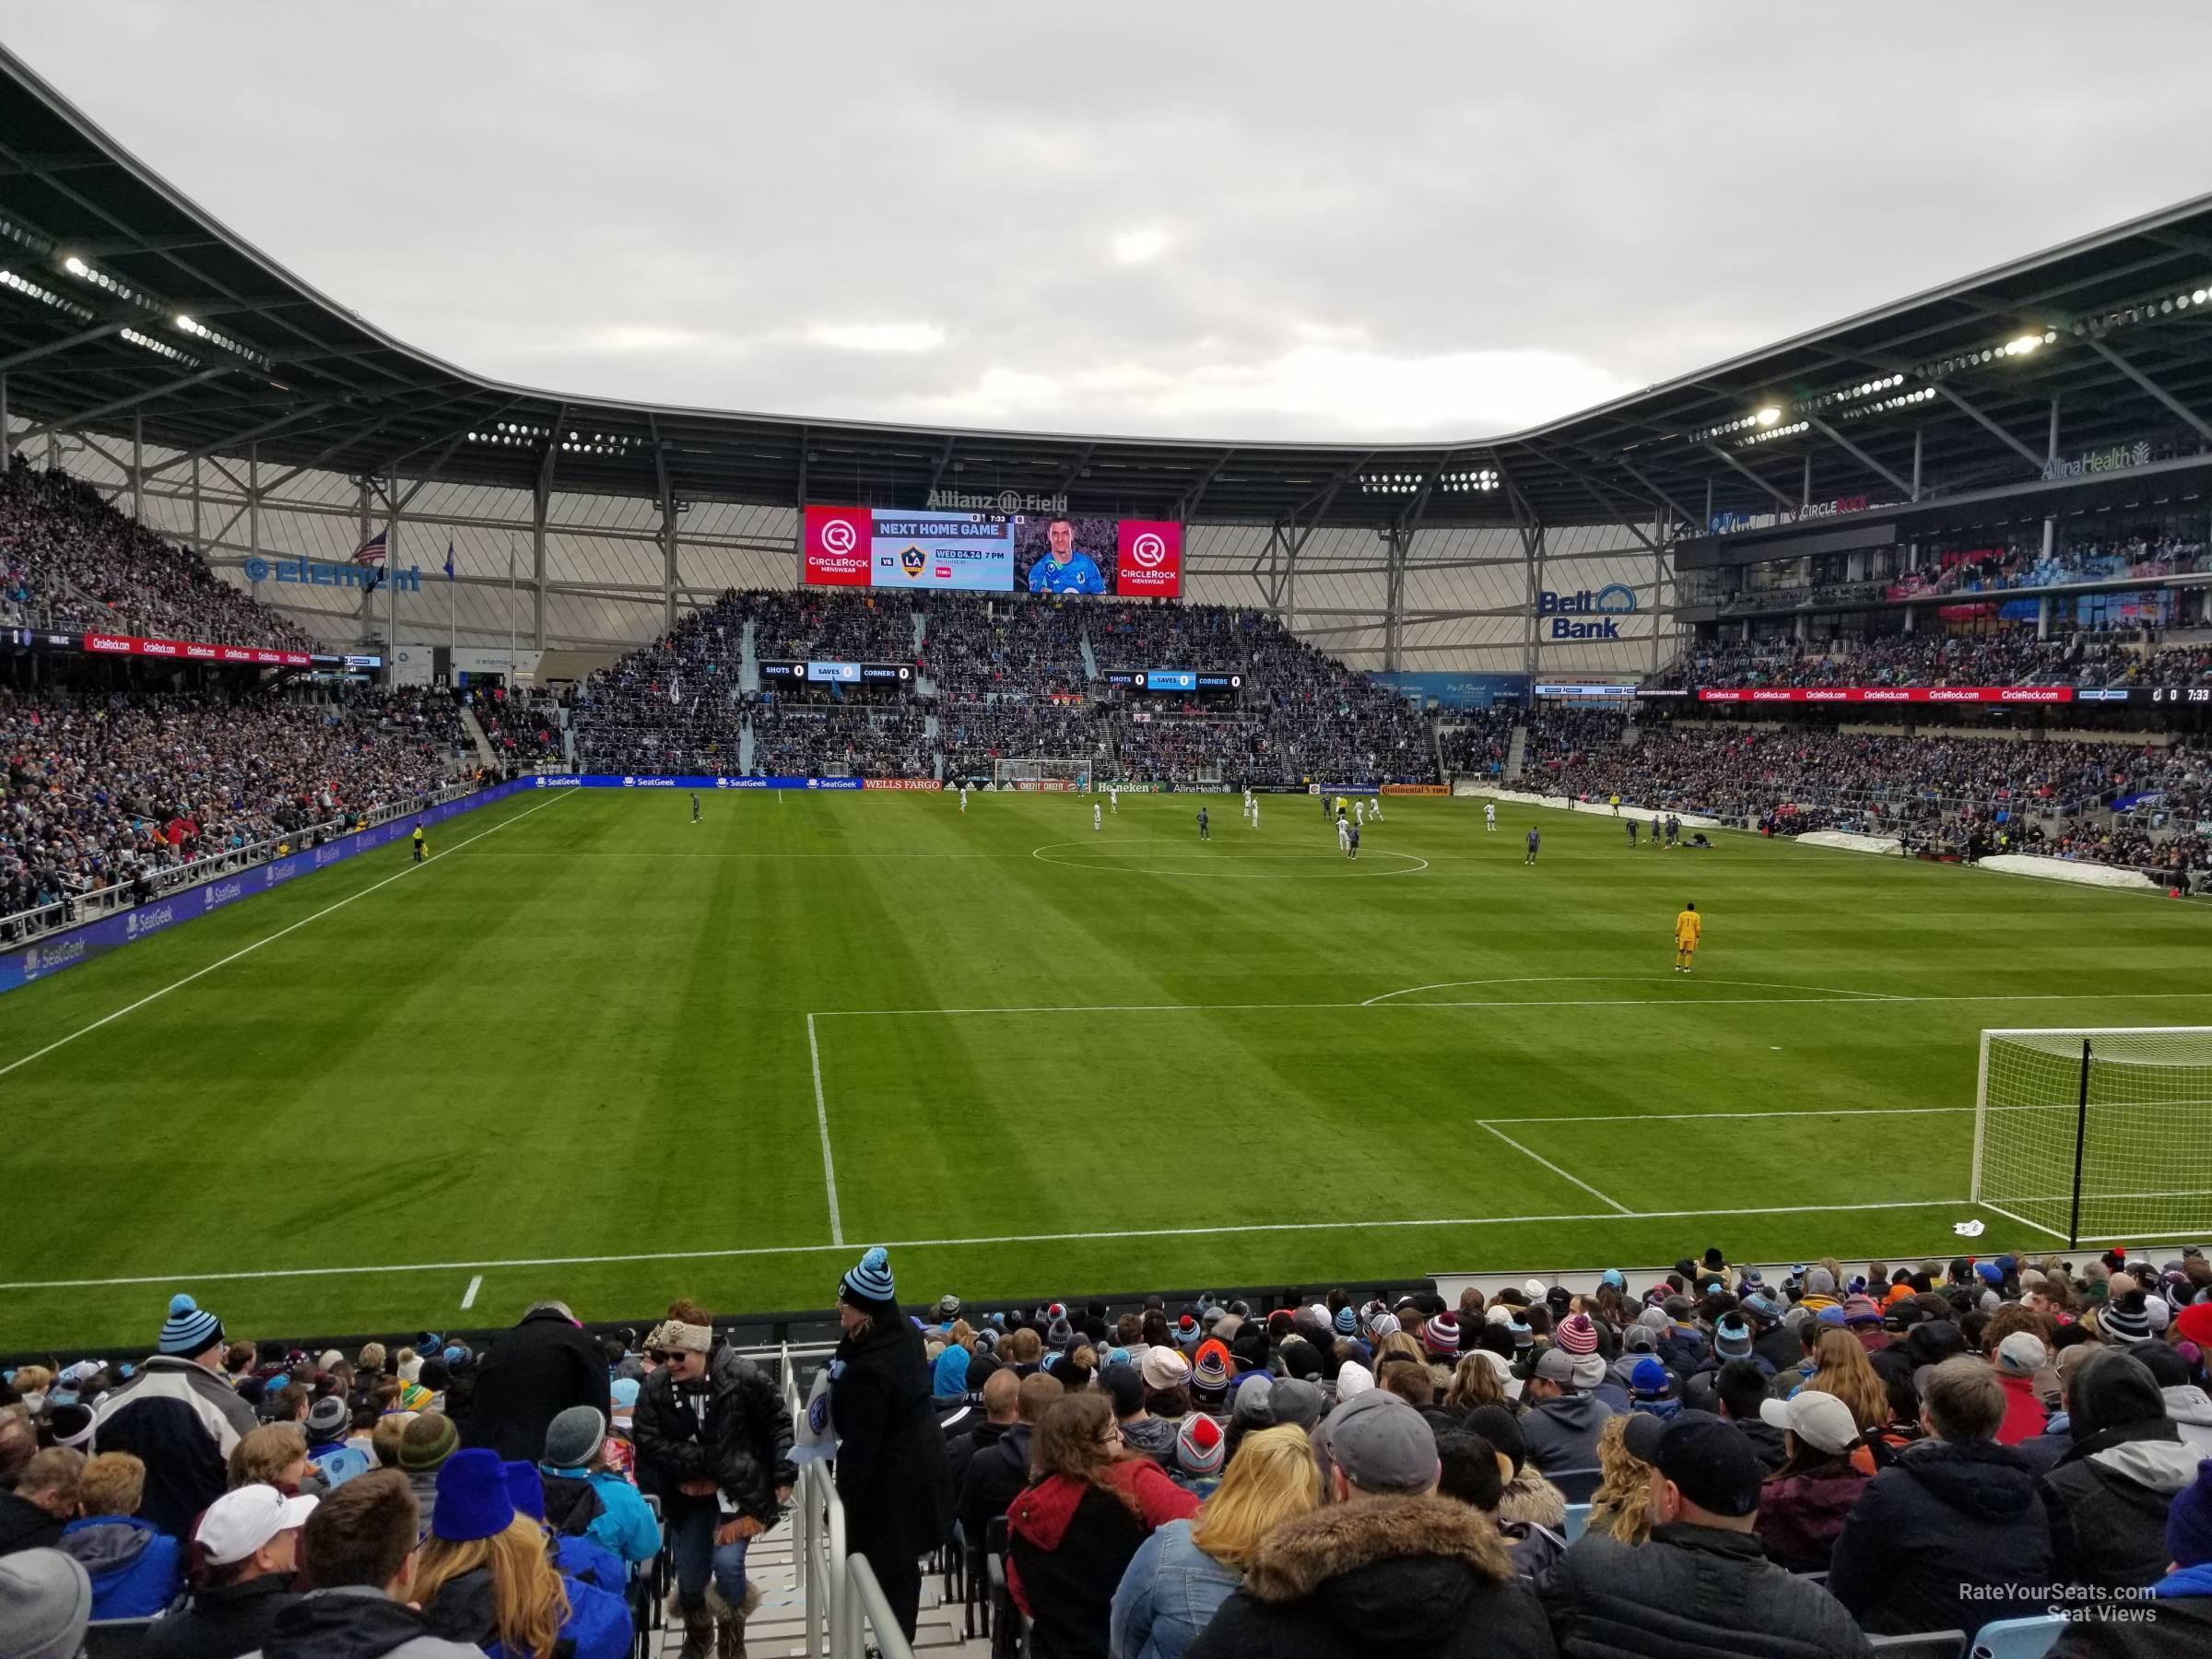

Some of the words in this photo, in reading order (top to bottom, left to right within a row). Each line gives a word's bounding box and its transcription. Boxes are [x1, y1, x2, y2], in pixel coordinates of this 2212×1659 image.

[2041, 457, 2081, 481] Allina
[2081, 446, 2131, 474] Health
[926, 489, 994, 509] Allianz
[1026, 494, 1067, 512] Field
[880, 524, 917, 535] NEXT
[920, 524, 959, 535] HOME
[960, 525, 999, 536] GAME
[905, 557, 922, 566] LA
[1539, 590, 1592, 614] Bell
[1552, 617, 1620, 639] Bank
[93, 638, 130, 651] CircleRock.com
[794, 665, 804, 677] 0
[842, 665, 853, 677] 0
[899, 667, 909, 679] 0
[1135, 675, 1145, 686] 0
[1180, 675, 1189, 686] 0
[1231, 677, 1241, 687] 0
[1930, 691, 1979, 700] CircleRock.com
[2002, 690, 2058, 700] CircleRock.com
[2171, 689, 2176, 700] 0
[2188, 689, 2209, 700] 7:33
[730, 779, 767, 787] SeatGeek
[866, 781, 900, 789] WELLS
[904, 781, 940, 790] FARGO
[1173, 783, 1195, 793] Allina
[1195, 783, 1222, 794] Health
[139, 906, 173, 932] SeatGeek
[42, 937, 85, 969] SeatGeek
